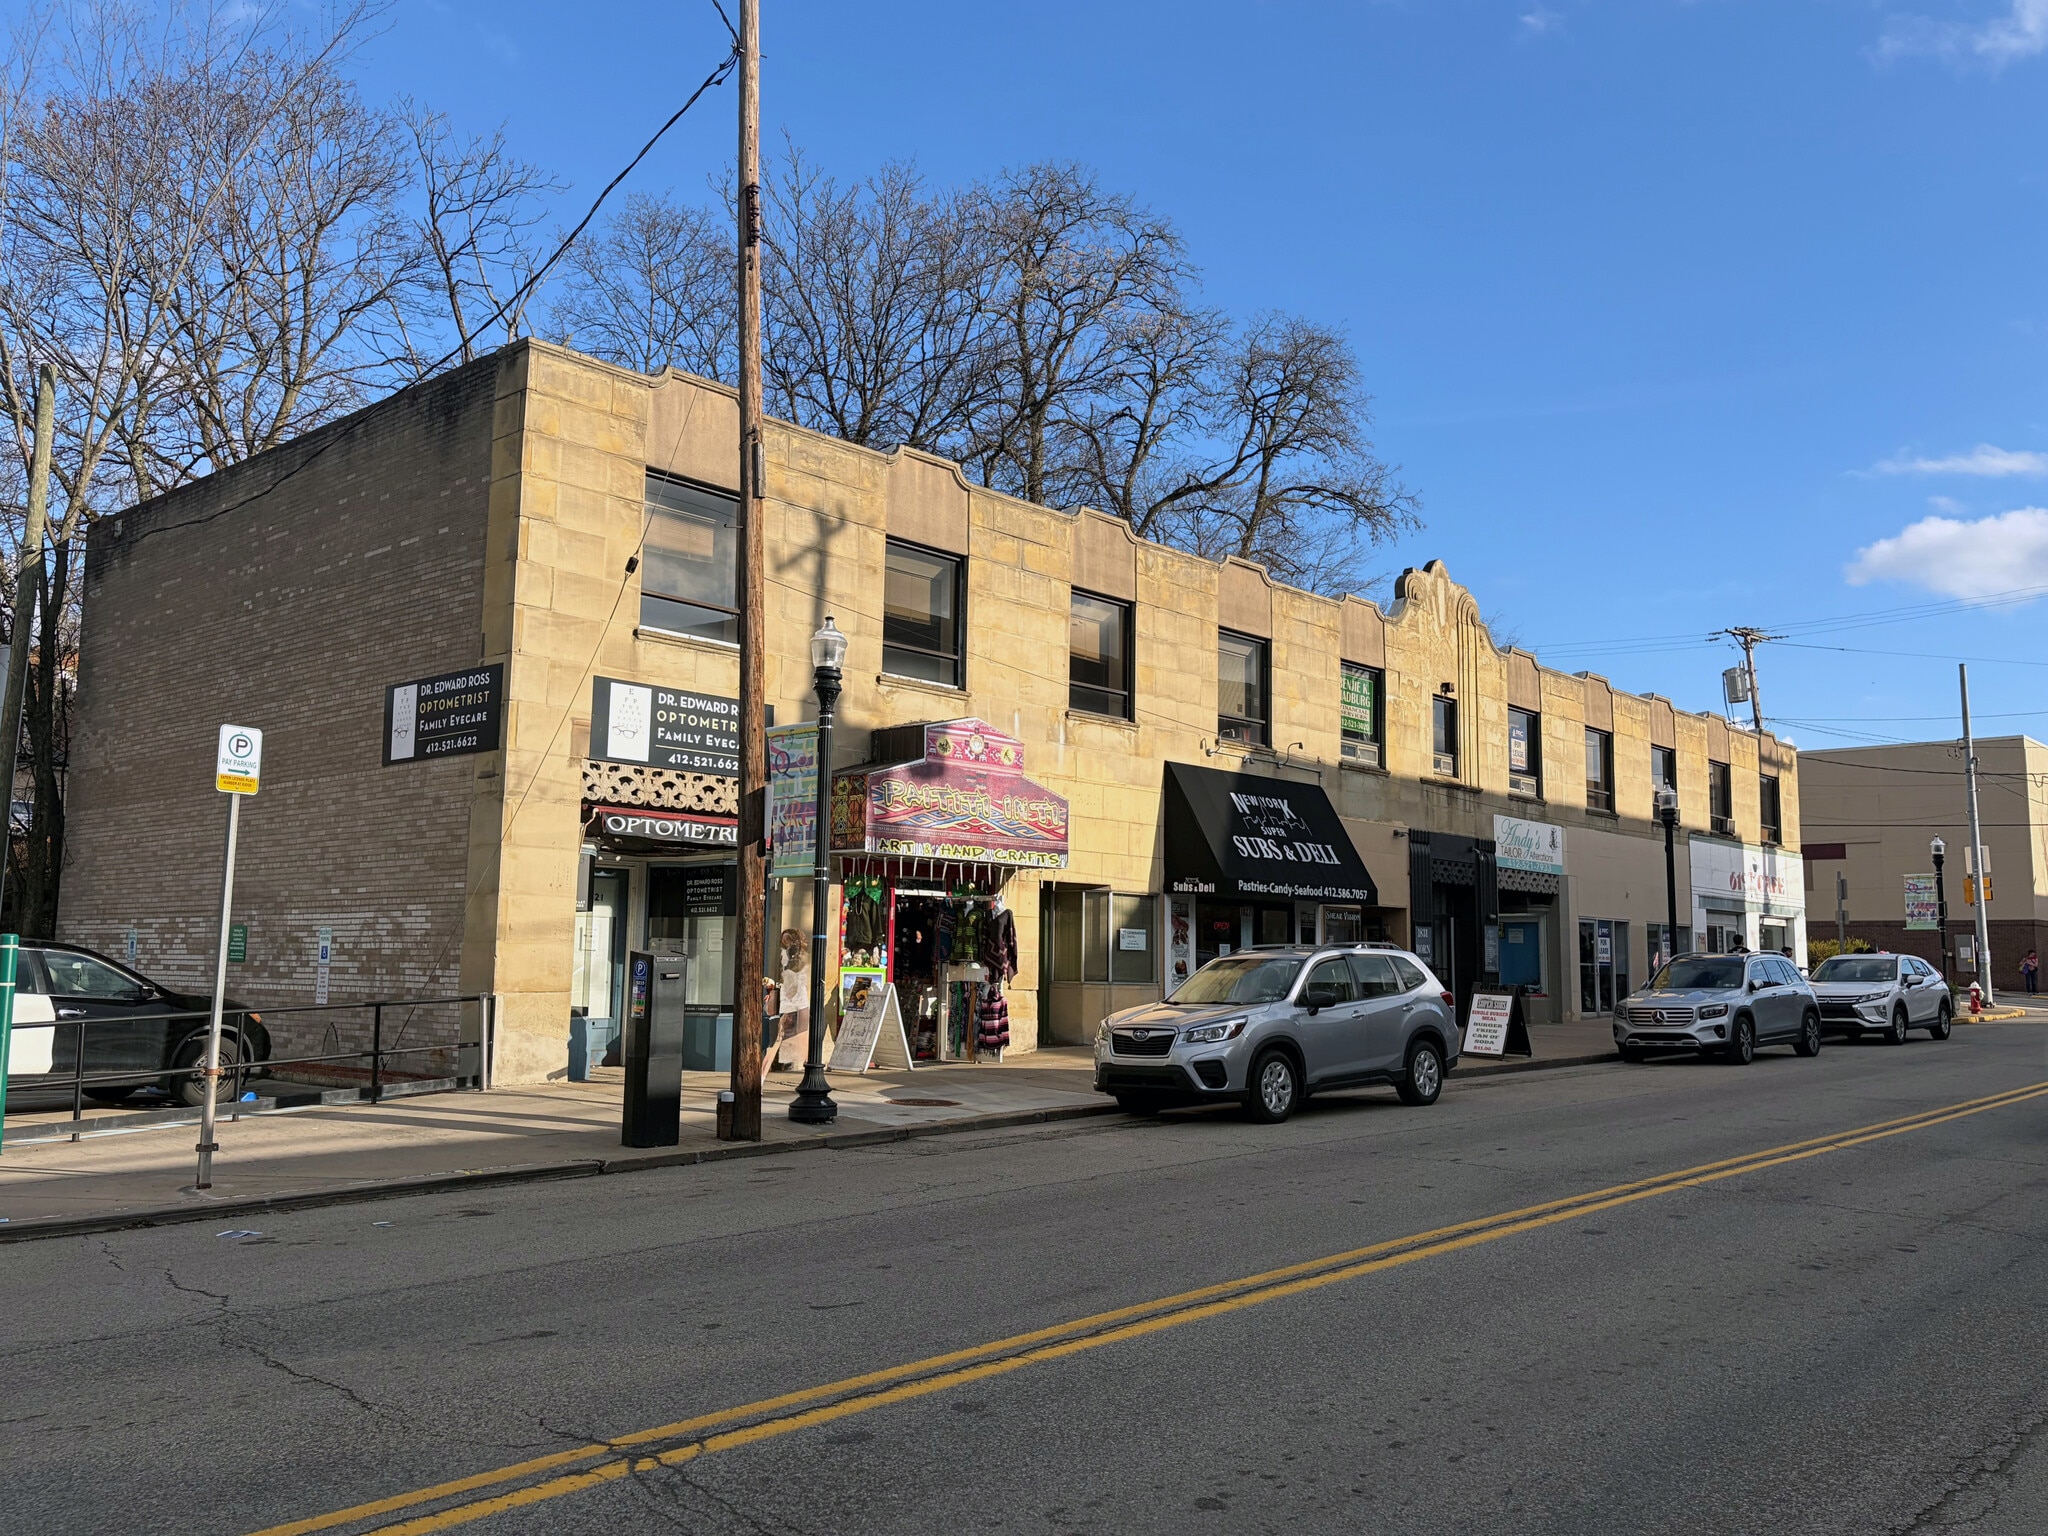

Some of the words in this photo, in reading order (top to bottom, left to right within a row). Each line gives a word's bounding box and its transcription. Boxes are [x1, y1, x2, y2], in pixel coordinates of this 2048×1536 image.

[421, 683, 434, 696] DR.
[434, 677, 467, 694] EDWARD
[468, 672, 490, 687] ROSS
[1340, 676, 1361, 694] ENJIE
[420, 690, 490, 714] OPTOMETRIST
[658, 692, 678, 706] DR.
[680, 696, 728, 714] EDWARD
[1341, 690, 1370, 708] ADBURG
[656, 710, 738, 732] OPTOMETR
[236, 738, 248, 753] P
[426, 736, 477, 754] 412.521.6622
[706, 734, 740, 750] EYEC
[222, 758, 232, 766] PAY
[234, 760, 256, 769] PARKING
[668, 754, 738, 771] 412.521.662
[881, 778, 990, 818] PAITITI
[1002, 794, 1060, 826] INTI
[606, 816, 738, 842] OPTOMETRI
[1260, 826, 1288, 838] SUPER
[1497, 818, 1540, 860] Andy's
[878, 837, 916, 852] ART
[924, 842, 931, 854] &
[940, 843, 986, 858] HAND
[994, 848, 1060, 865] CRAFTS
[1232, 835, 1283, 860] SUBS
[1283, 845, 1298, 862] &
[1292, 841, 1342, 864] DELI
[1500, 846, 1522, 858] TAILOR
[1508, 860, 1552, 872] 412-521-7933
[1173, 881, 1194, 892] Subs
[1198, 882, 1215, 893] Deli
[1324, 886, 1368, 900] 412.586.7057
[1214, 922, 1230, 930] OPEN
